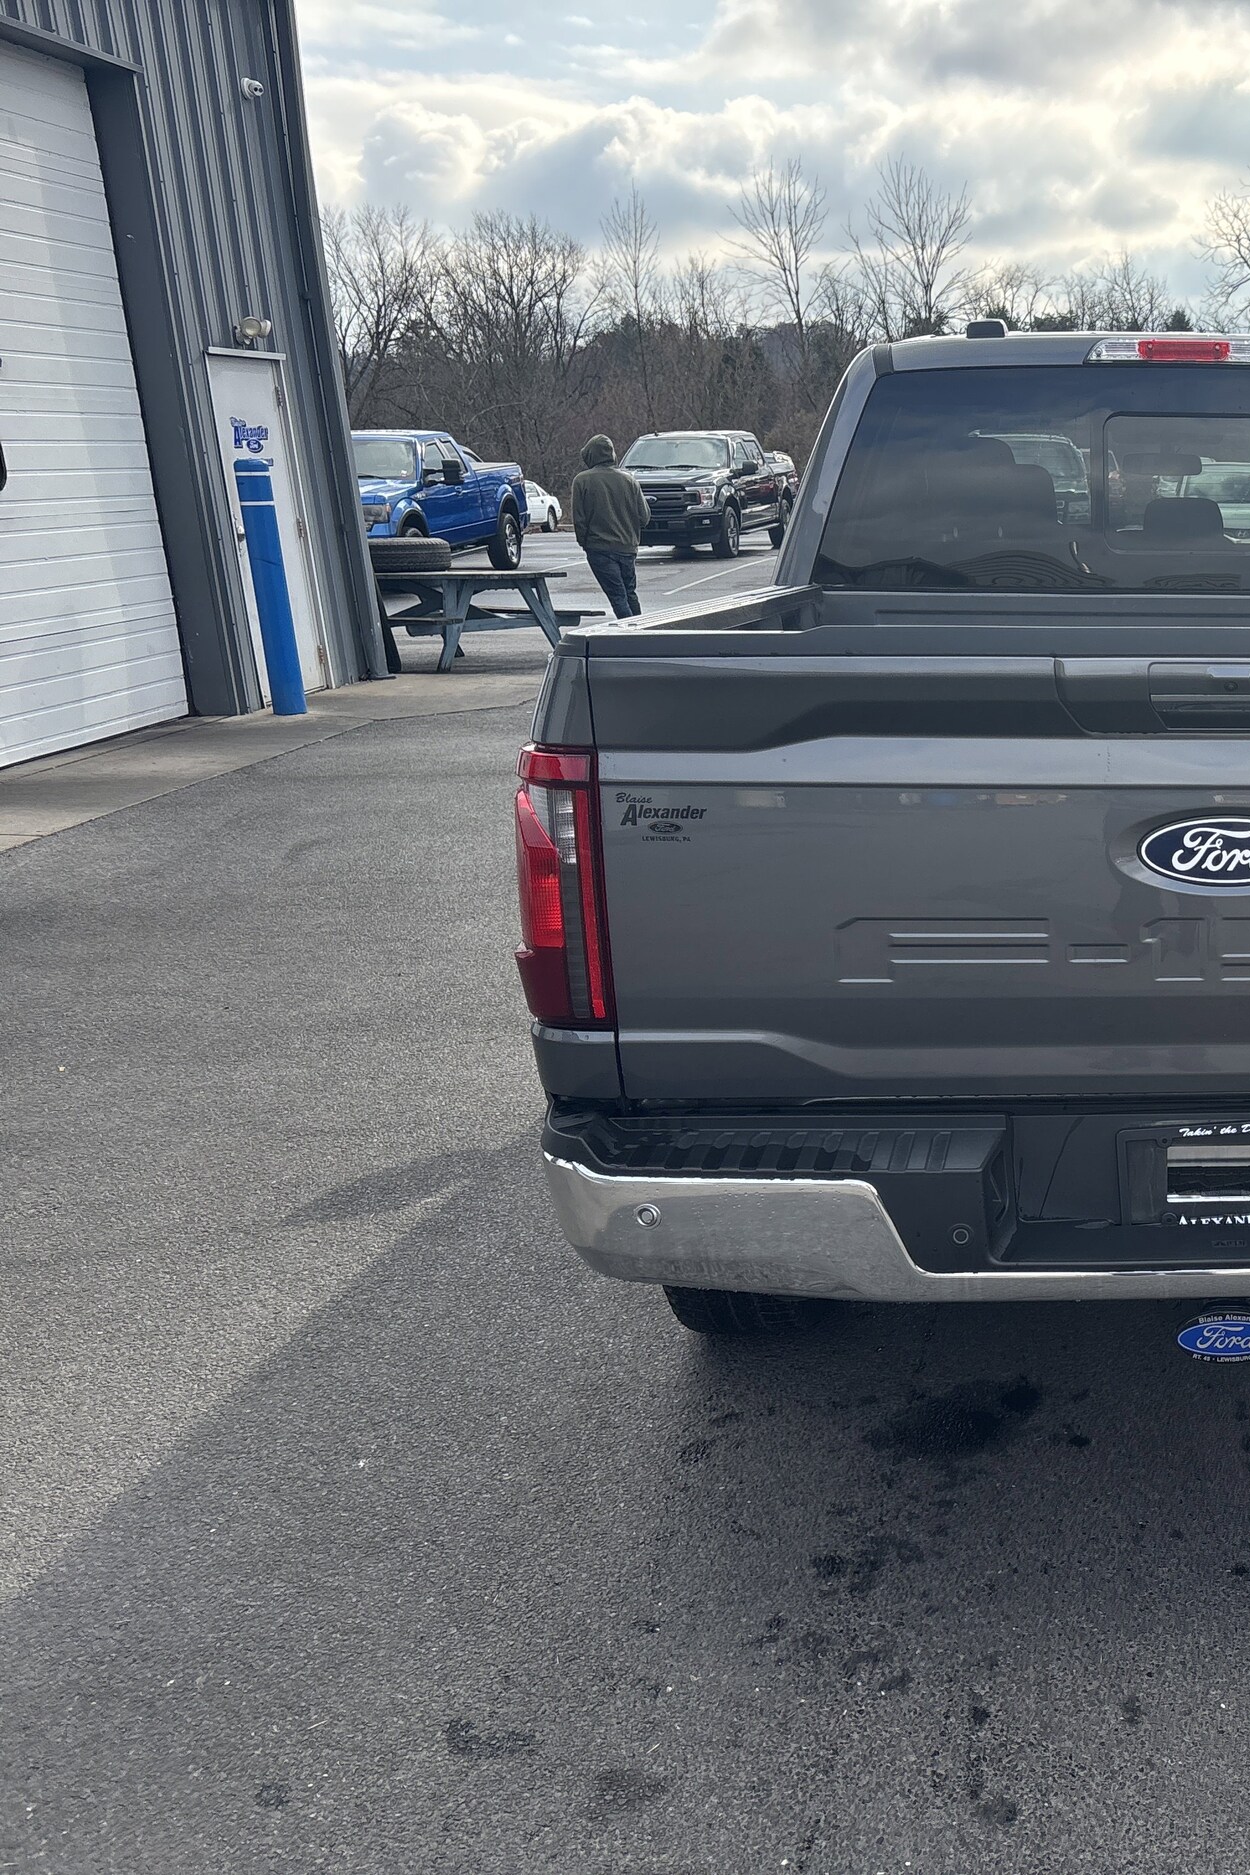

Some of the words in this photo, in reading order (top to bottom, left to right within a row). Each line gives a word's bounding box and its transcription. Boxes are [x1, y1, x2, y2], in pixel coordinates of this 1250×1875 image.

[234, 426, 268, 448] Alexander
[615, 792, 653, 804] Blaise
[620, 804, 707, 826] Alexander
[1179, 1126, 1217, 1137] Takin'
[1219, 1125, 1237, 1135] the
